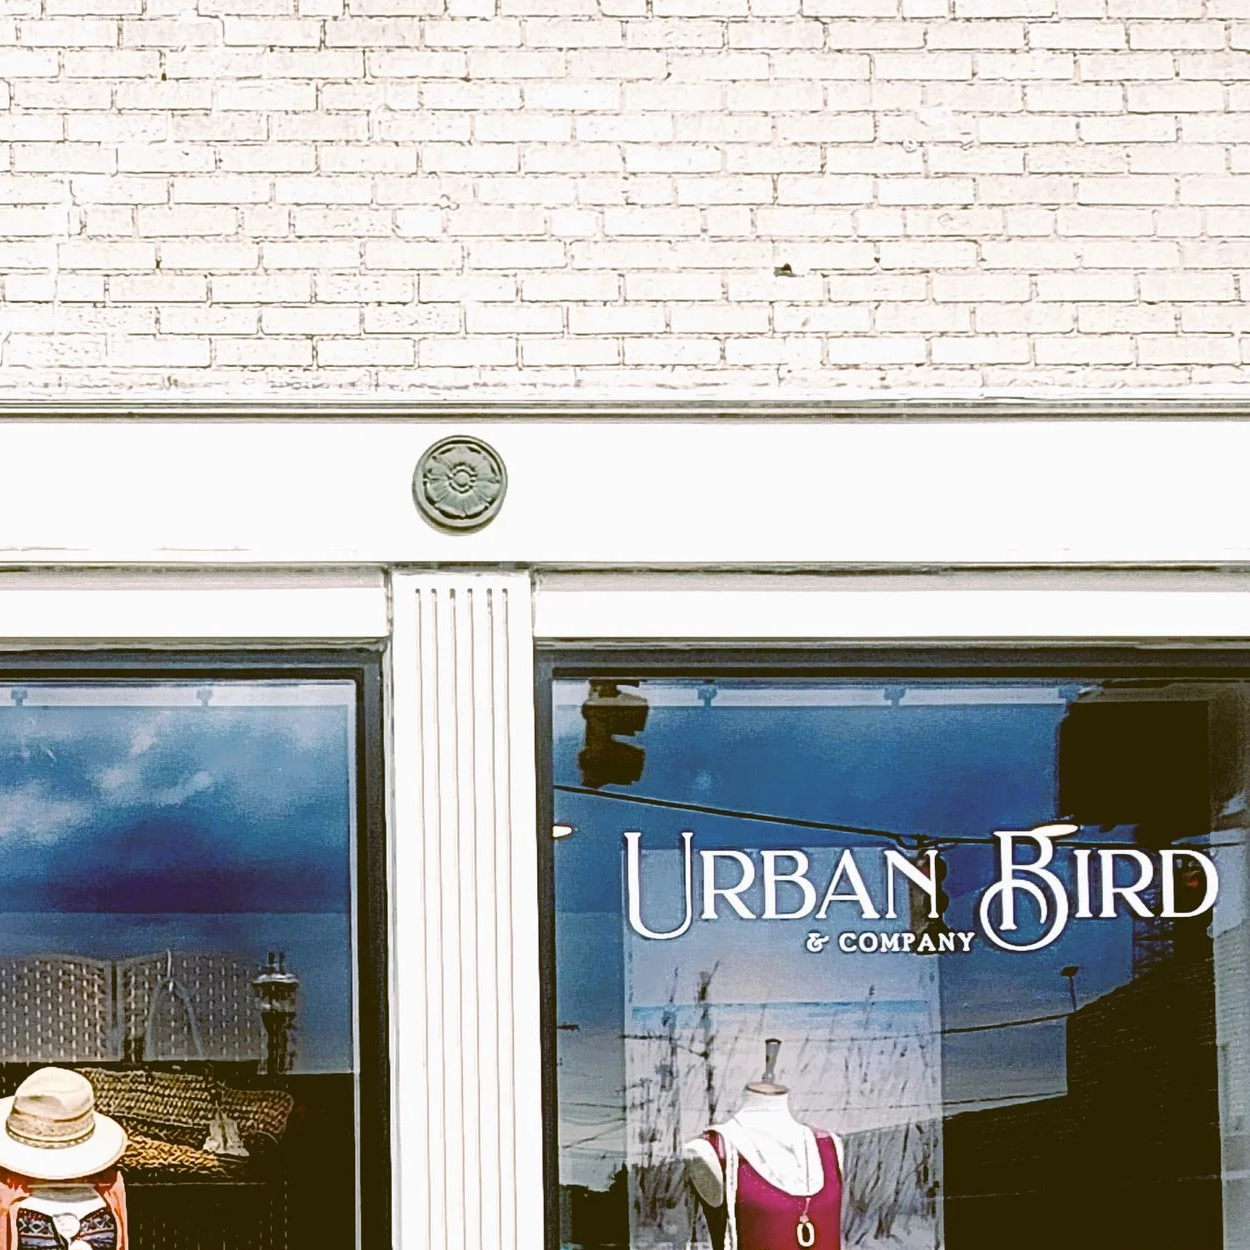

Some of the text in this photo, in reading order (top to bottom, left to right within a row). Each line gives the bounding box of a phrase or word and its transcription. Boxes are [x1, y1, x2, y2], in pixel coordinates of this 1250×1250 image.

[624, 830, 1220, 952] URBAN BIRD
[806, 932, 976, 953] & COMPANY
